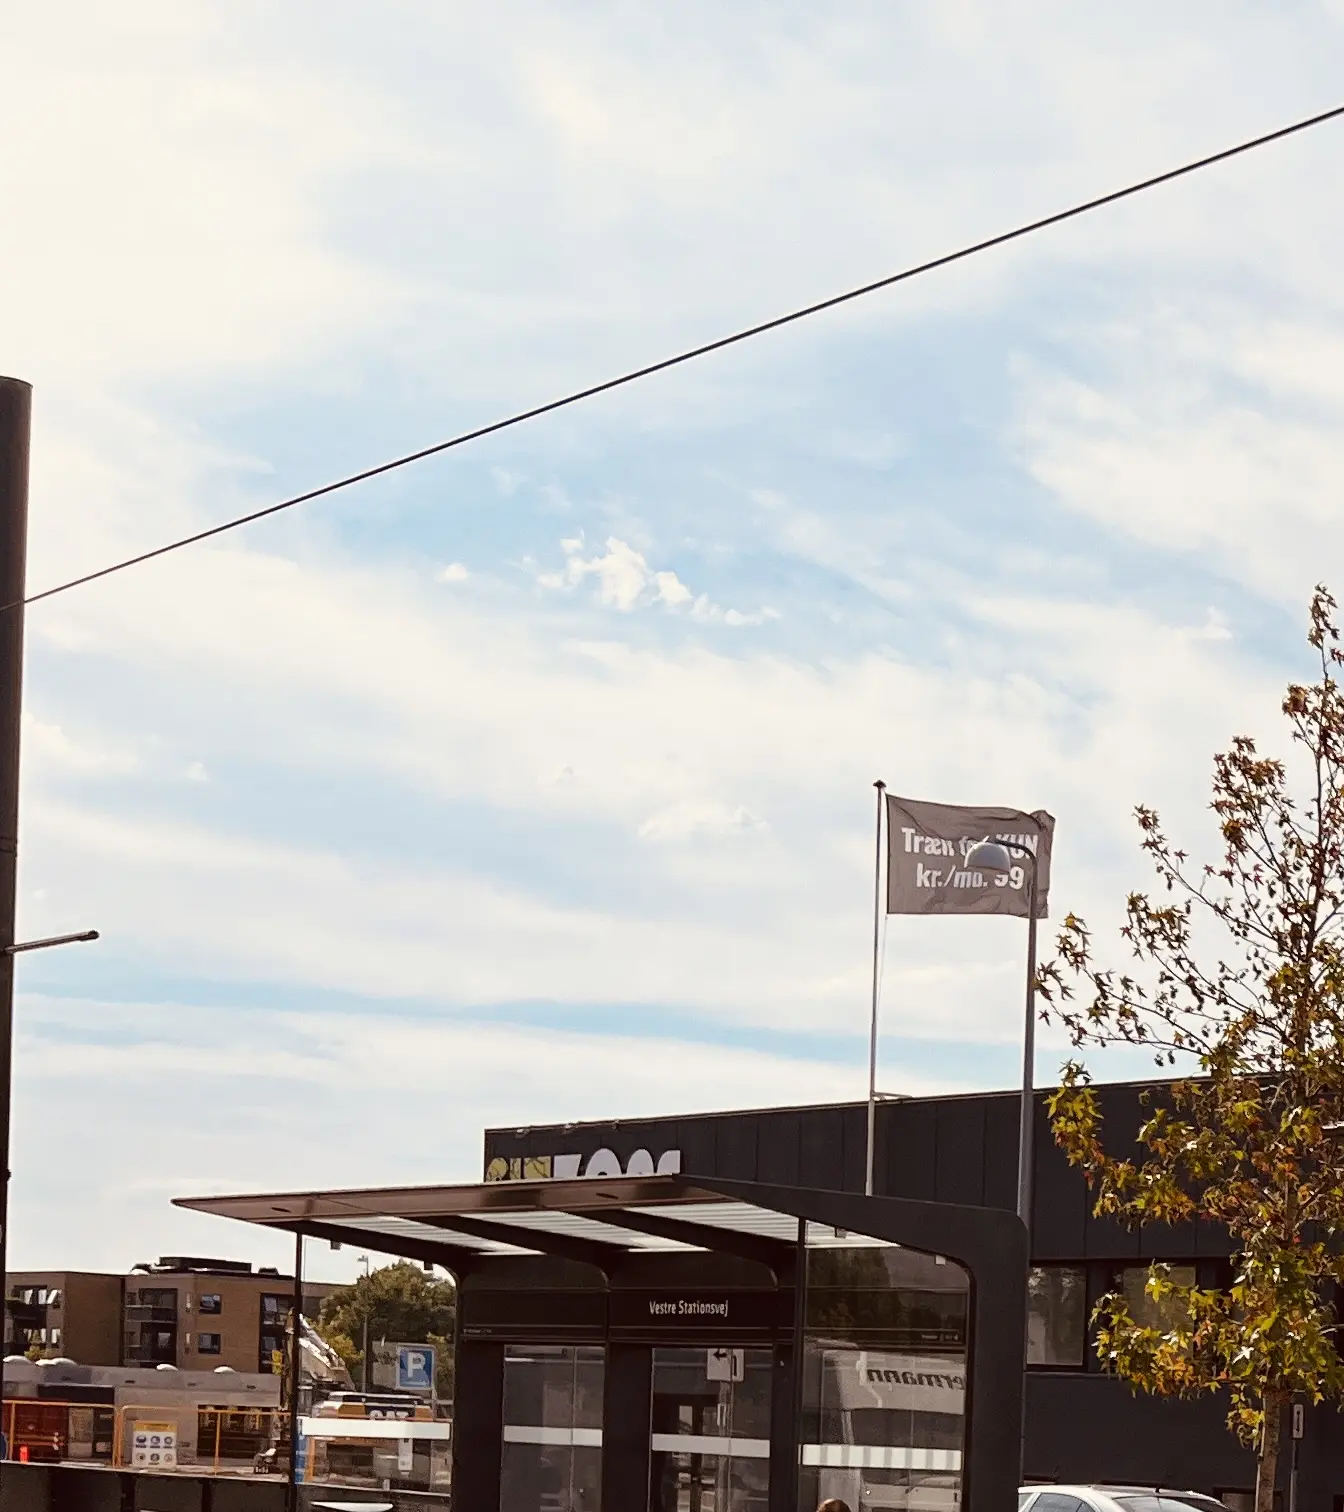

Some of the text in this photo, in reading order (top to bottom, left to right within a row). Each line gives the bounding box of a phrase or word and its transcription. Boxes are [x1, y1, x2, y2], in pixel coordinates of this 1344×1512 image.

[901, 827, 955, 857] Træn
[648, 1299, 729, 1318] Vestre Stationsvej
[407, 1352, 426, 1379] P
